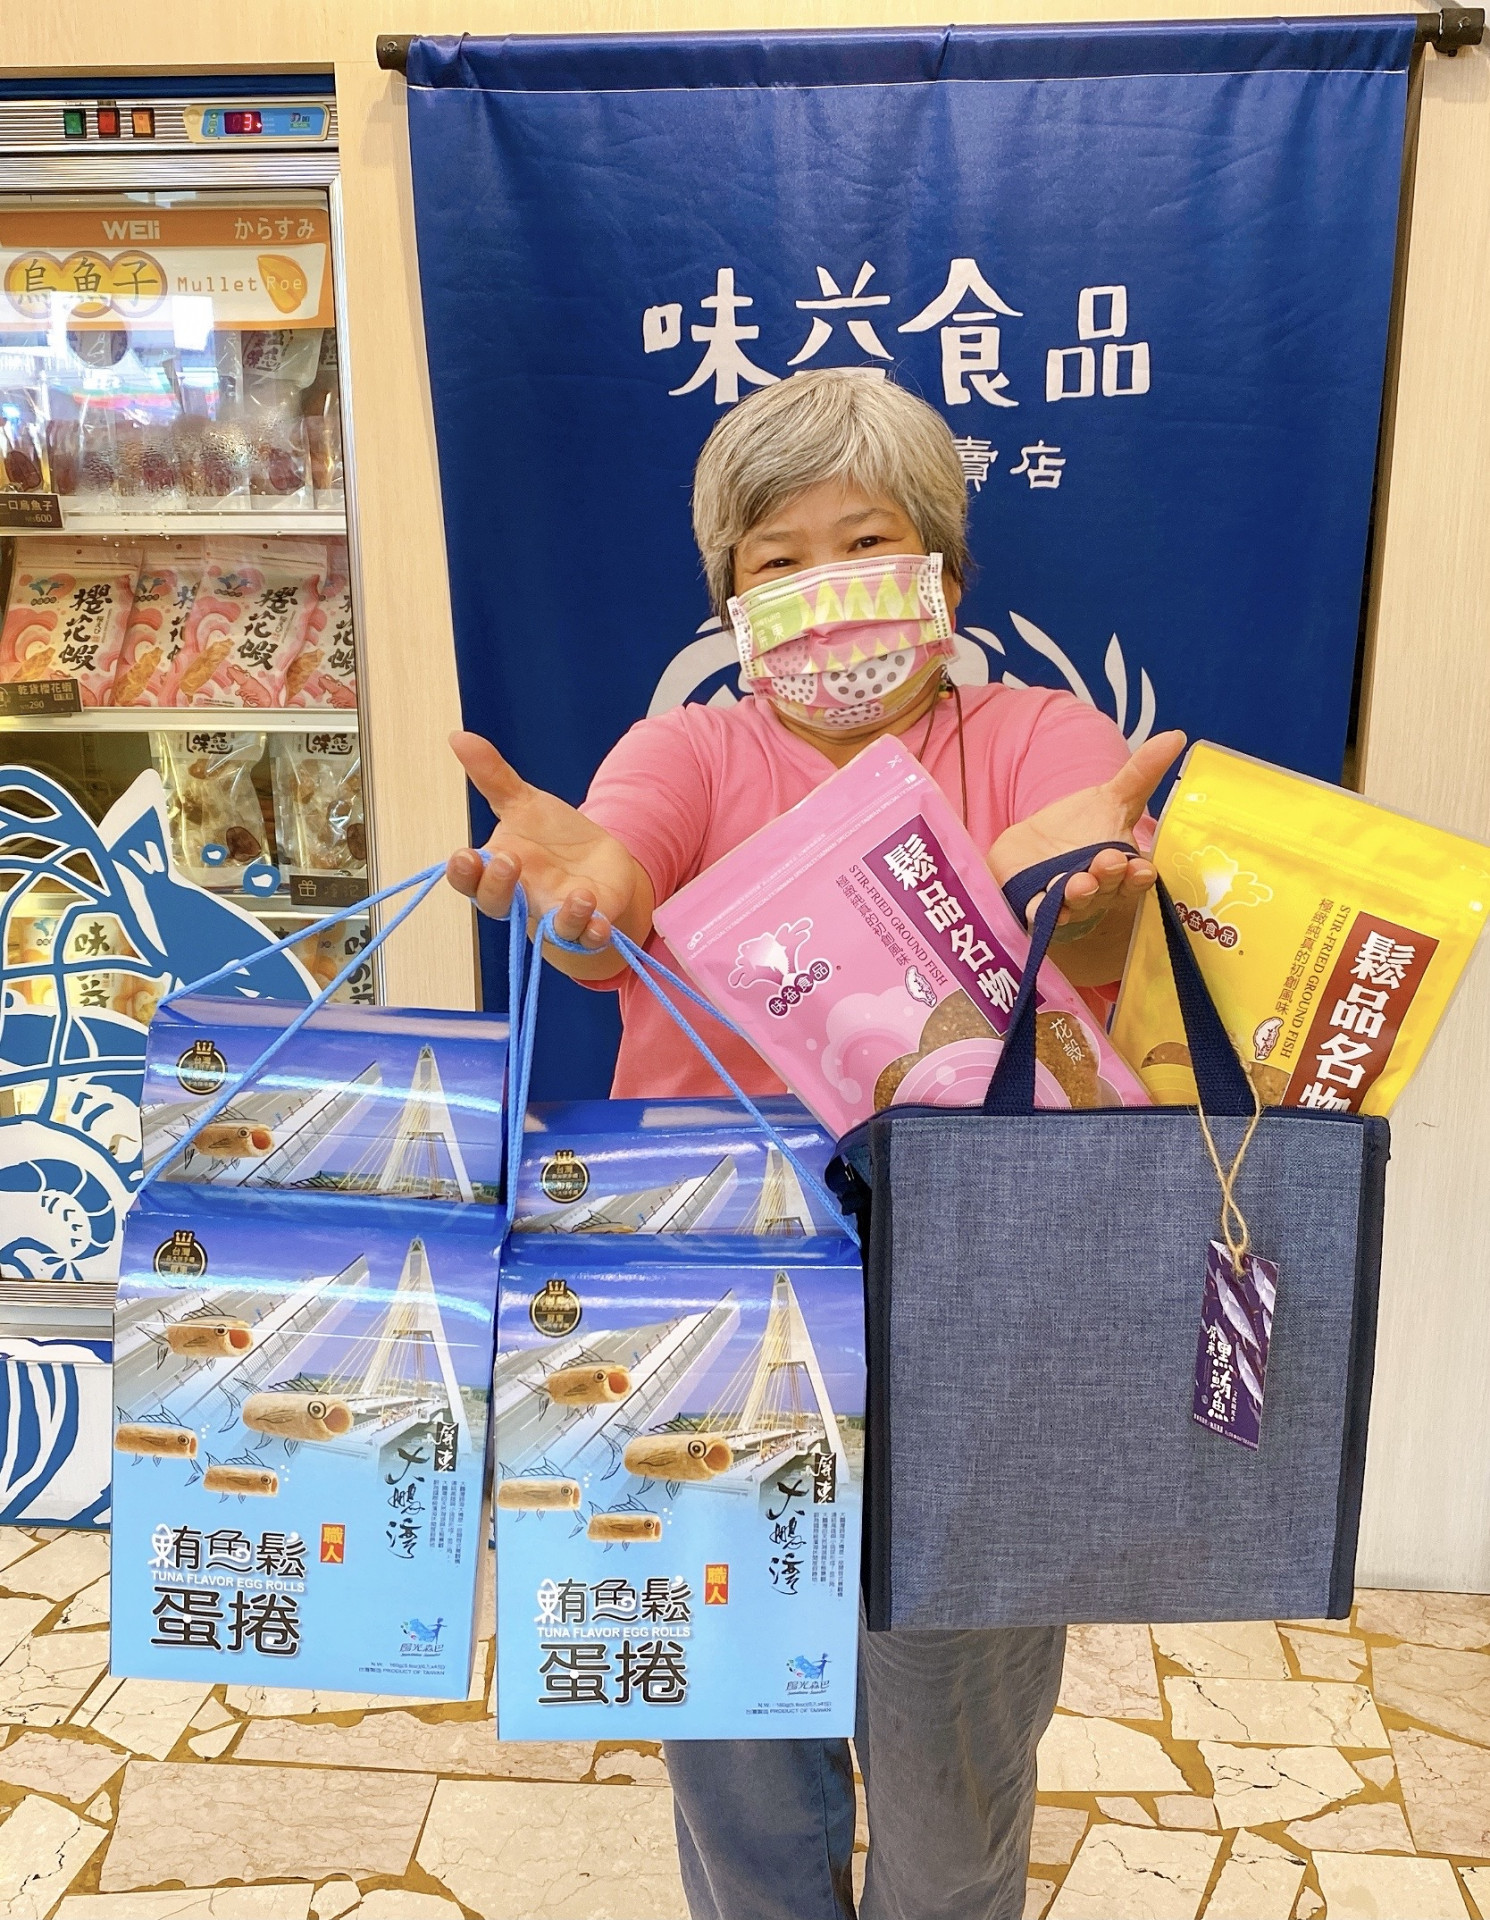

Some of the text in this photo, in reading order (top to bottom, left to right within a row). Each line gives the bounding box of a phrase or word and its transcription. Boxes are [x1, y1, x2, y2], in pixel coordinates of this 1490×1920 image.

[234, 216, 315, 240] からすみ
[178, 276, 303, 292] Mullet Roe
[849, 864, 894, 918] STIR-FRIED
[890, 916, 928, 962] GROUND
[924, 961, 948, 987] FISH
[883, 832, 1021, 1015] 鬆品名物
[771, 963, 828, 1014] 味益食品
[1280, 904, 1351, 1060] STIR-FRIED GROUND FISH
[148, 1523, 307, 1579] 鮪魚鬆
[324, 1526, 343, 1563] 職人
[152, 1570, 305, 1593] TUNA FLAVOR EGG ROLLS
[534, 1576, 693, 1624] 鮪魚鬆
[706, 1567, 728, 1603] 職人
[150, 1586, 300, 1656] 蛋捲
[537, 1626, 690, 1638] TUNA FLAVOR EGG ROLLS
[538, 1640, 688, 1706] 蛋捲
